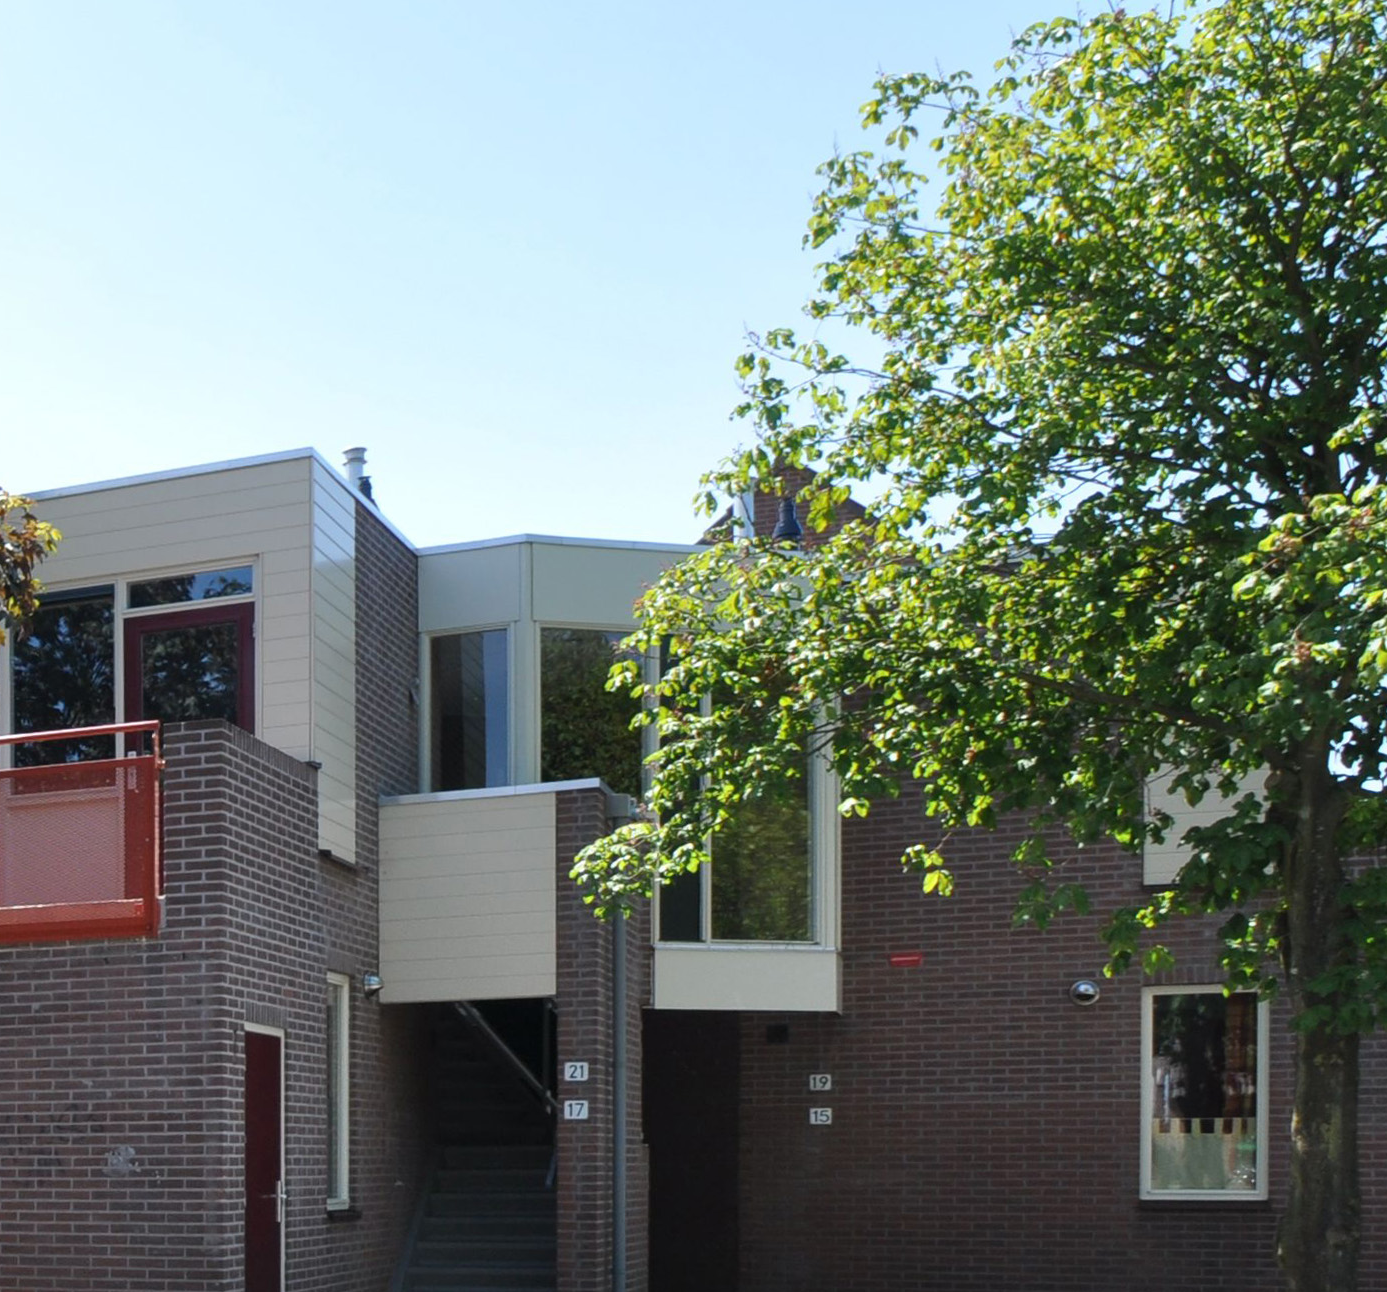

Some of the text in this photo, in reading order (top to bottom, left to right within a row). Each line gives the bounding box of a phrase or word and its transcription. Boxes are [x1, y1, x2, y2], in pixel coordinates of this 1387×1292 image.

[568, 1064, 584, 1079] 21
[812, 1075, 829, 1089] 19
[567, 1103, 584, 1117] 17
[812, 1110, 830, 1123] 15
